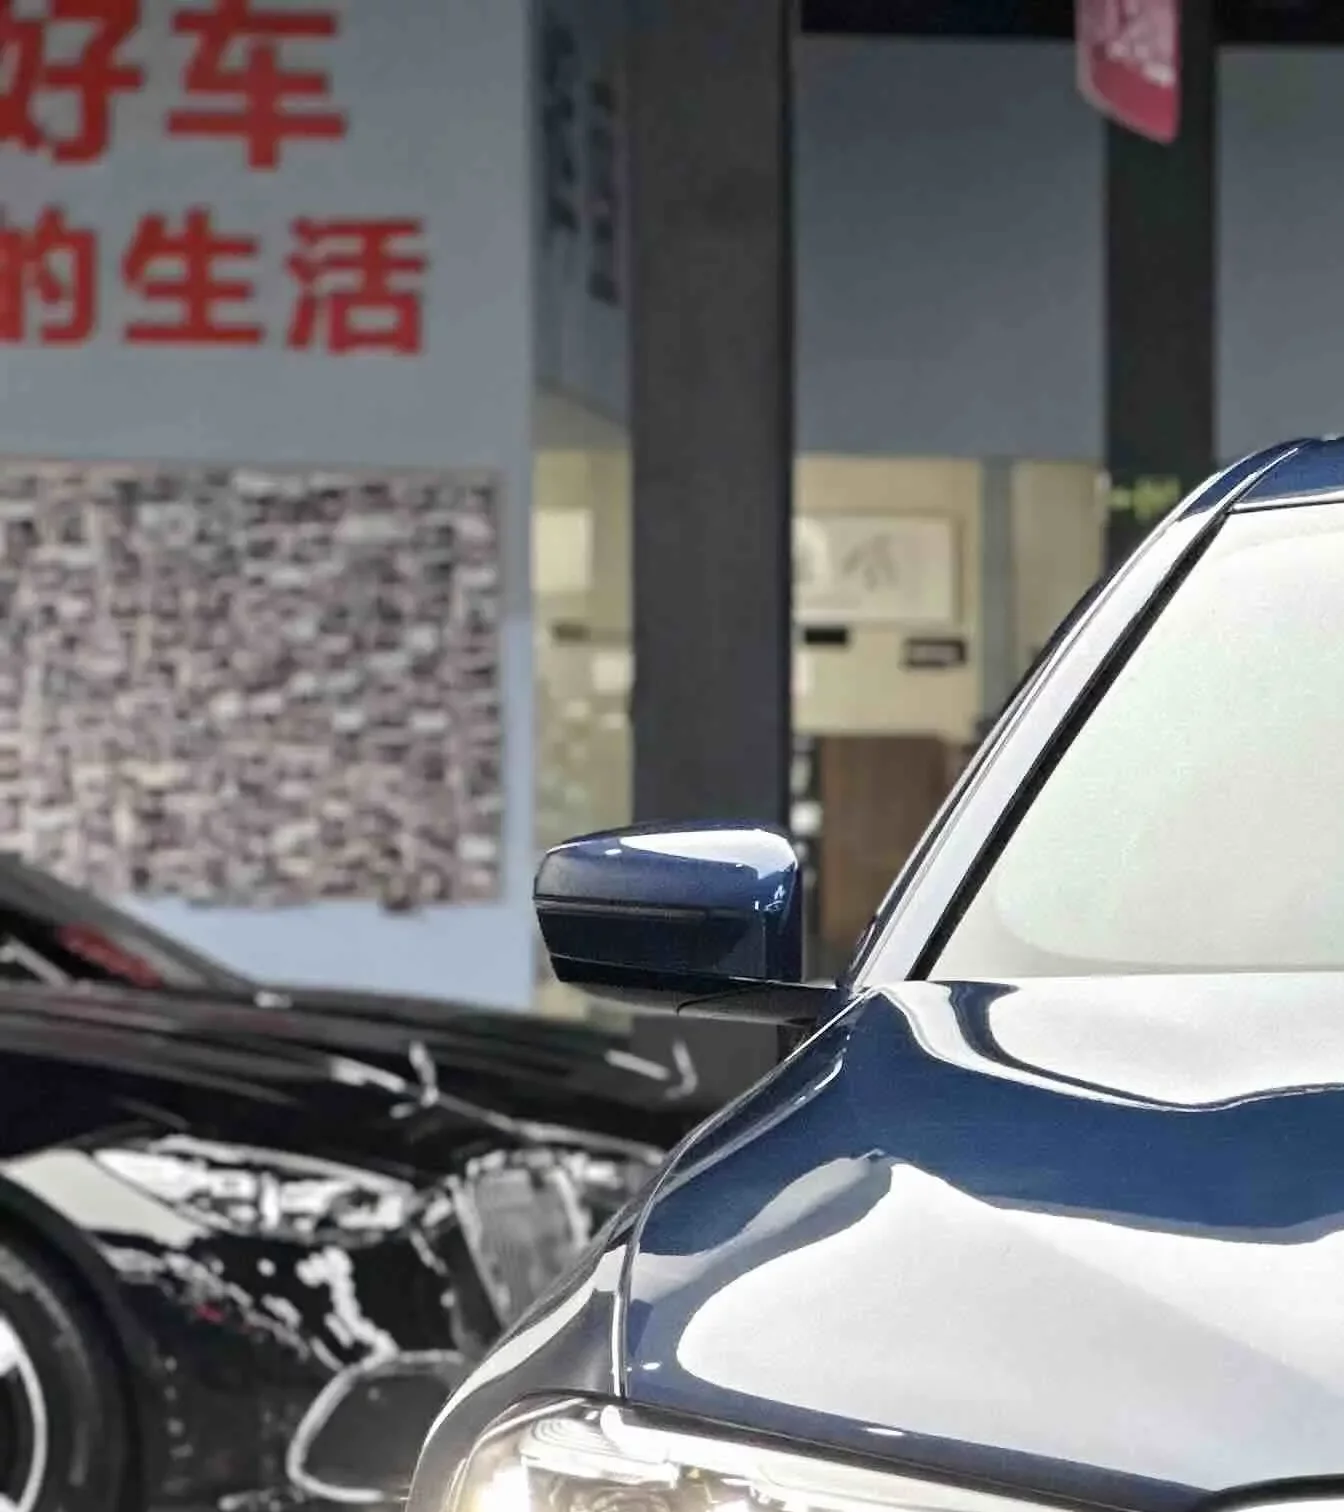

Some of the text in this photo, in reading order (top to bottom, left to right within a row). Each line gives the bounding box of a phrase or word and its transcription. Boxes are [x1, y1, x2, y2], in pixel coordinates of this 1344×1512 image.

[0, 0, 347, 171] 好车
[0, 206, 428, 356] 的生活
